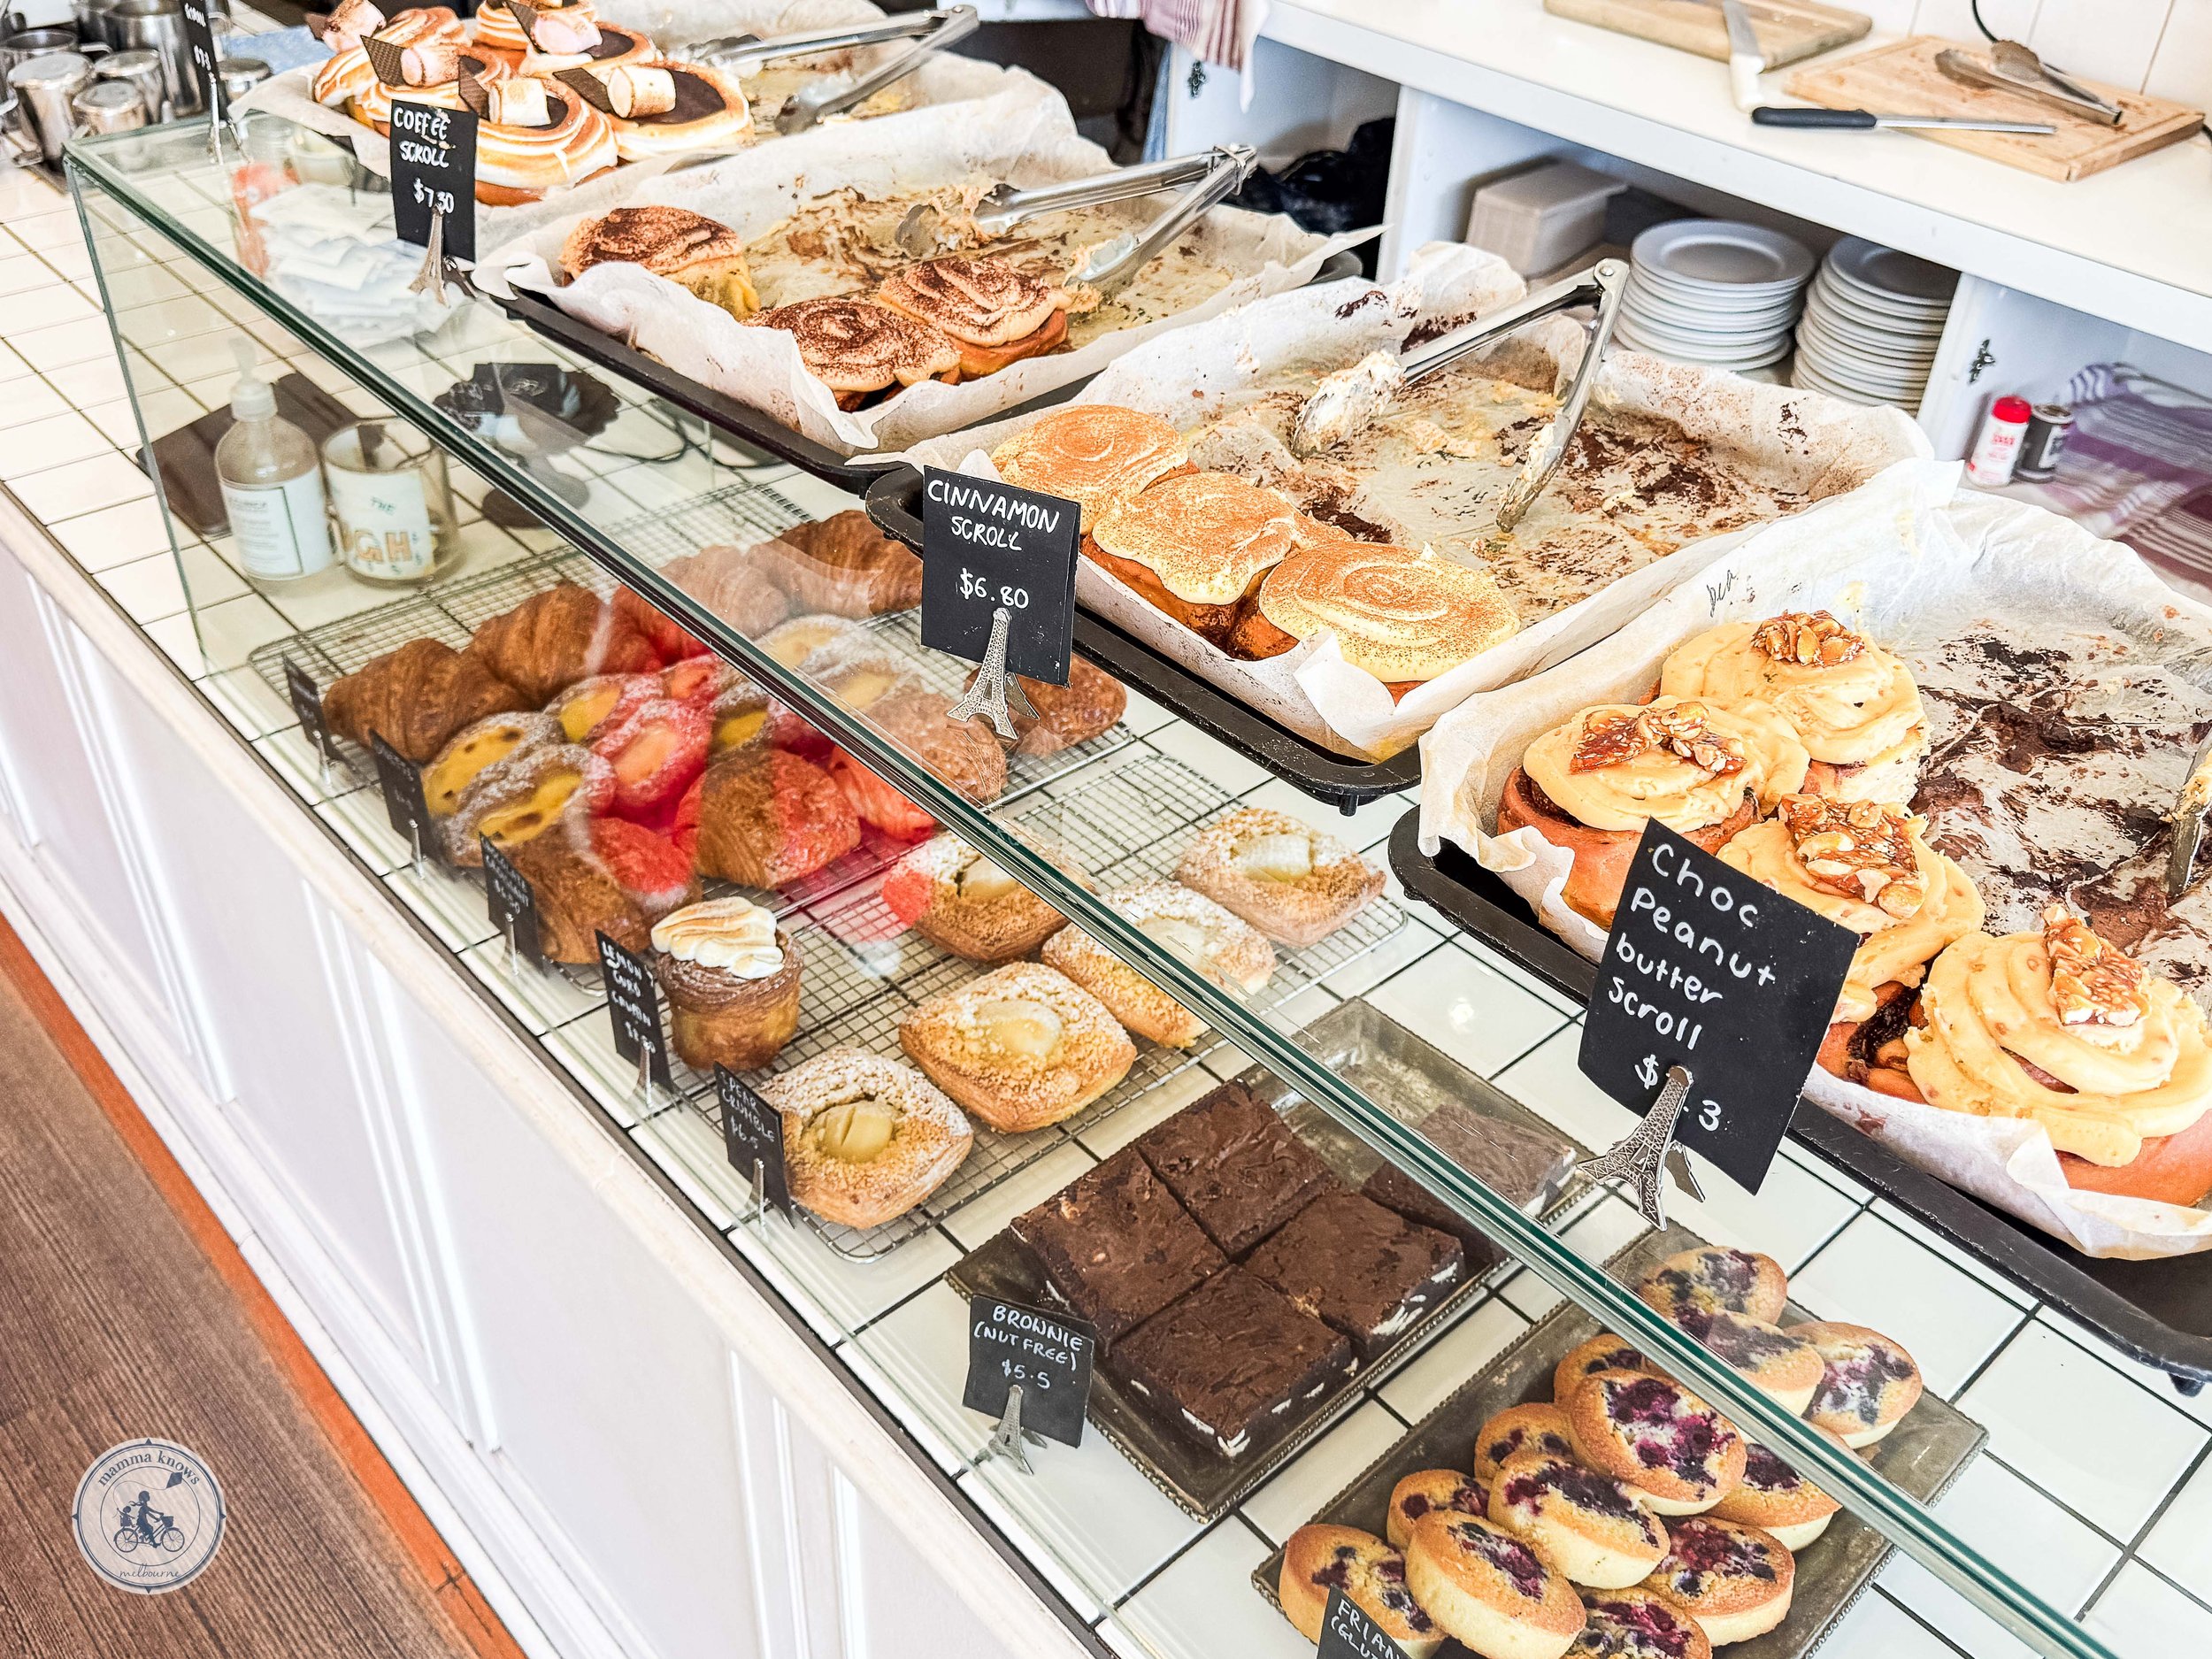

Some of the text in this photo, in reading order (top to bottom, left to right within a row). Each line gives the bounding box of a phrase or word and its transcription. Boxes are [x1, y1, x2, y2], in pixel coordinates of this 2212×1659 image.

[394, 107, 448, 140] COFFEE
[399, 141, 449, 168] SCROLL
[927, 479, 1060, 534] CINNAMON
[950, 516, 1023, 551] SCROLL
[960, 567, 1029, 609] $6.80
[1652, 842, 1759, 927] Choc
[1617, 933, 1724, 1006] butter
[974, 1321, 1077, 1371] (NUT FREE)
[993, 1305, 1083, 1352] BROWNIE
[1002, 1359, 1051, 1390] $5.5
